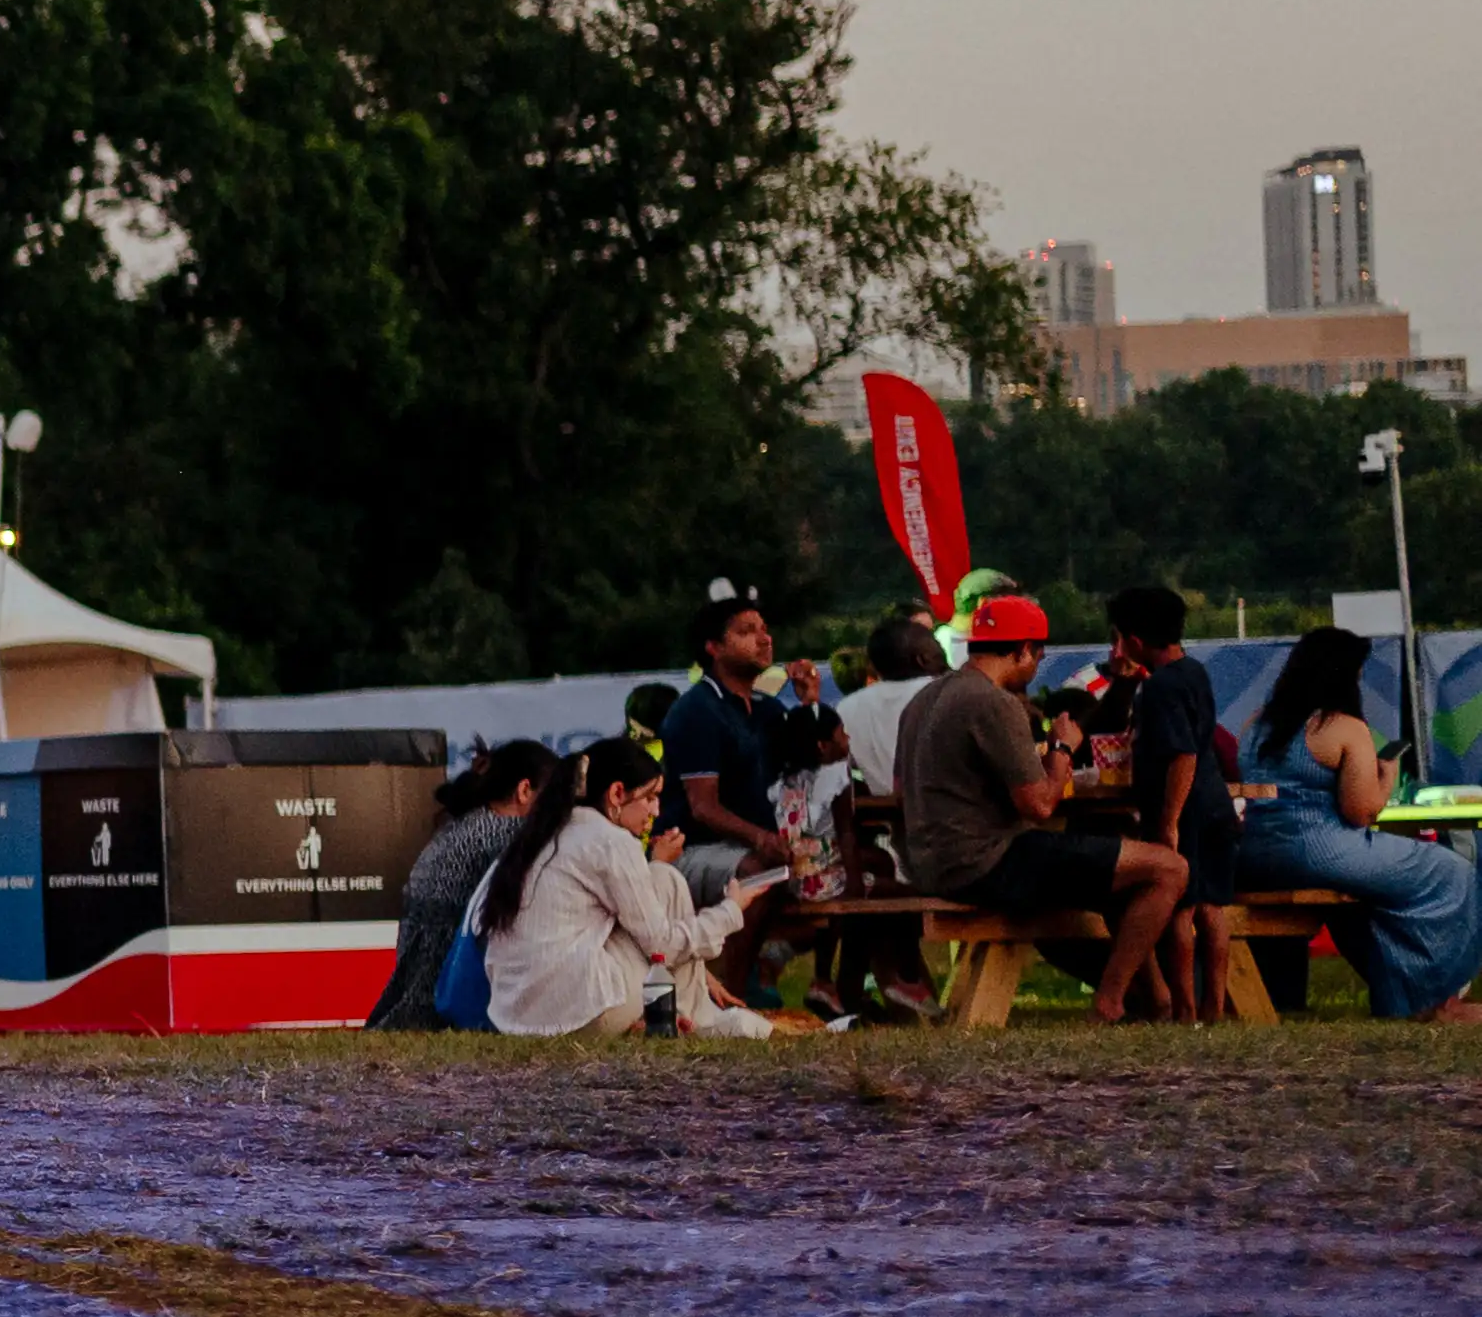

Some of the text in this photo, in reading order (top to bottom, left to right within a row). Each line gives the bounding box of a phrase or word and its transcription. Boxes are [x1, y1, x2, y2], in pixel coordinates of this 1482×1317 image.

[82, 798, 120, 813] WASTE
[275, 798, 336, 816] WASTE
[49, 873, 159, 888] EVERYTHING ELSE HERE
[236, 876, 383, 893] EVERYTHING ELSE HERE
